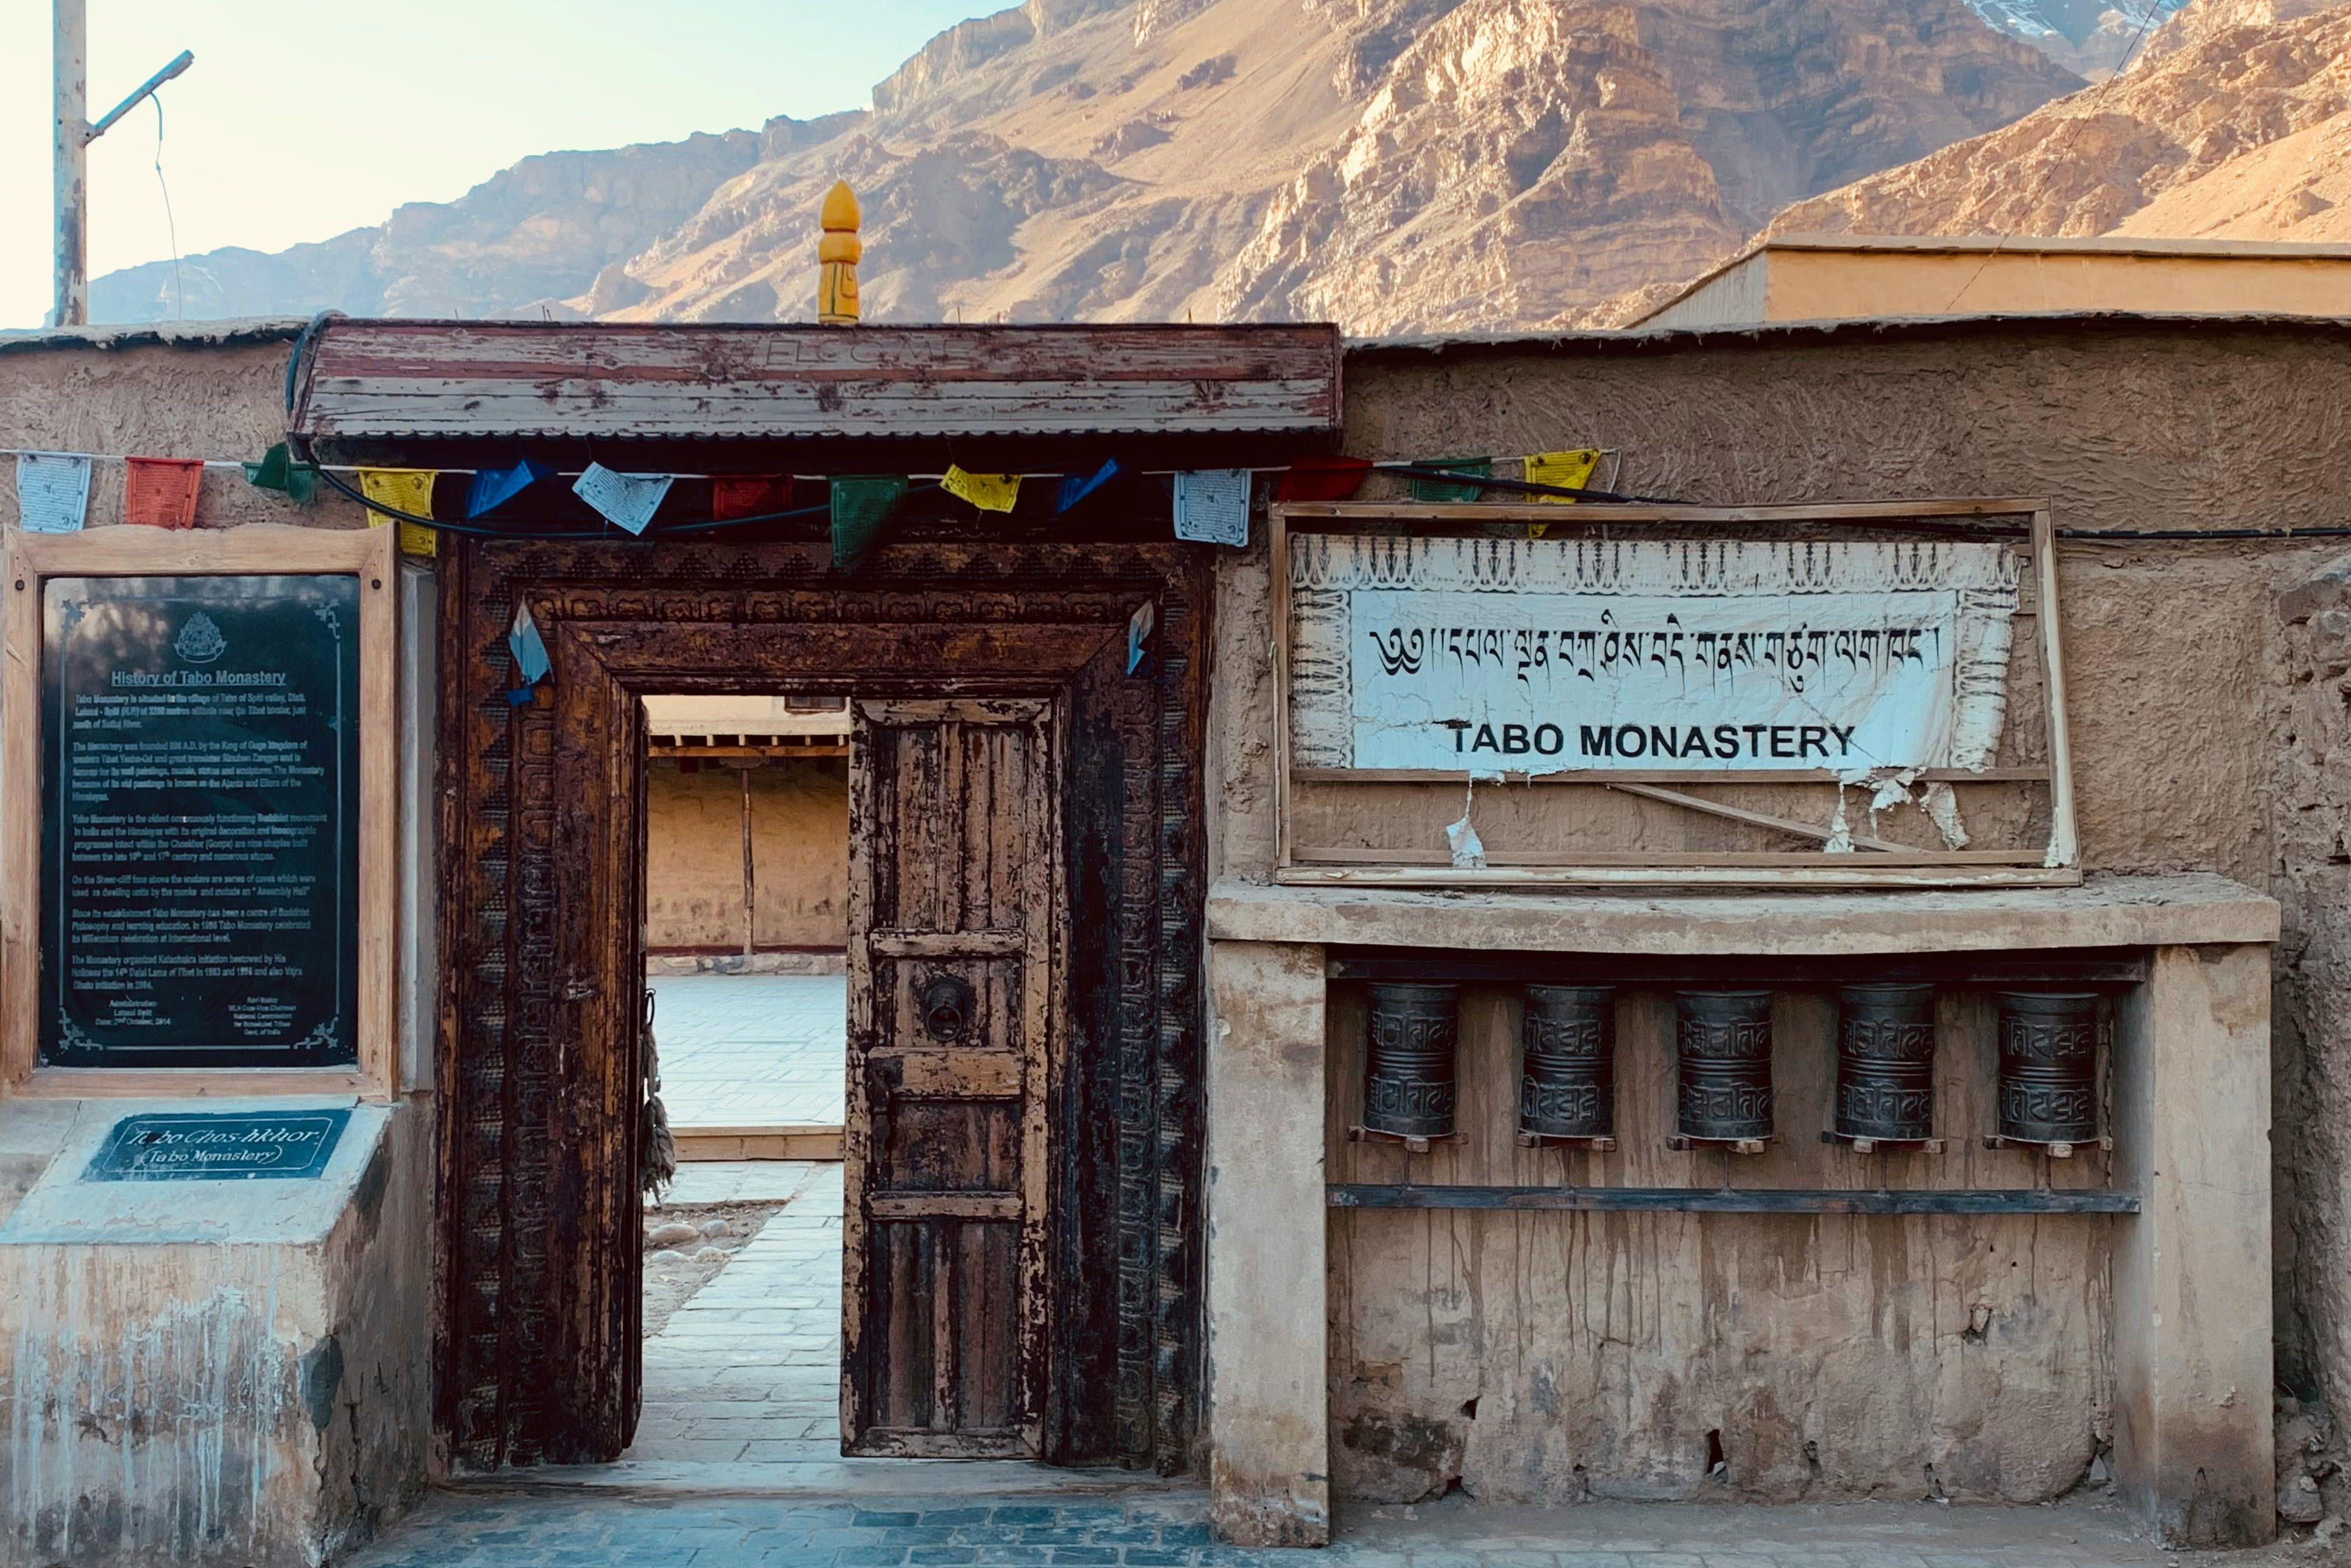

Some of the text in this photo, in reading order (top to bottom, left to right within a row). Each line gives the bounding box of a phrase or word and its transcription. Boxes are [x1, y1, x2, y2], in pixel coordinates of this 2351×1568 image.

[111, 670, 286, 686] History of Tabo Monastery
[1448, 724, 1855, 759] TABO MONASTERY
